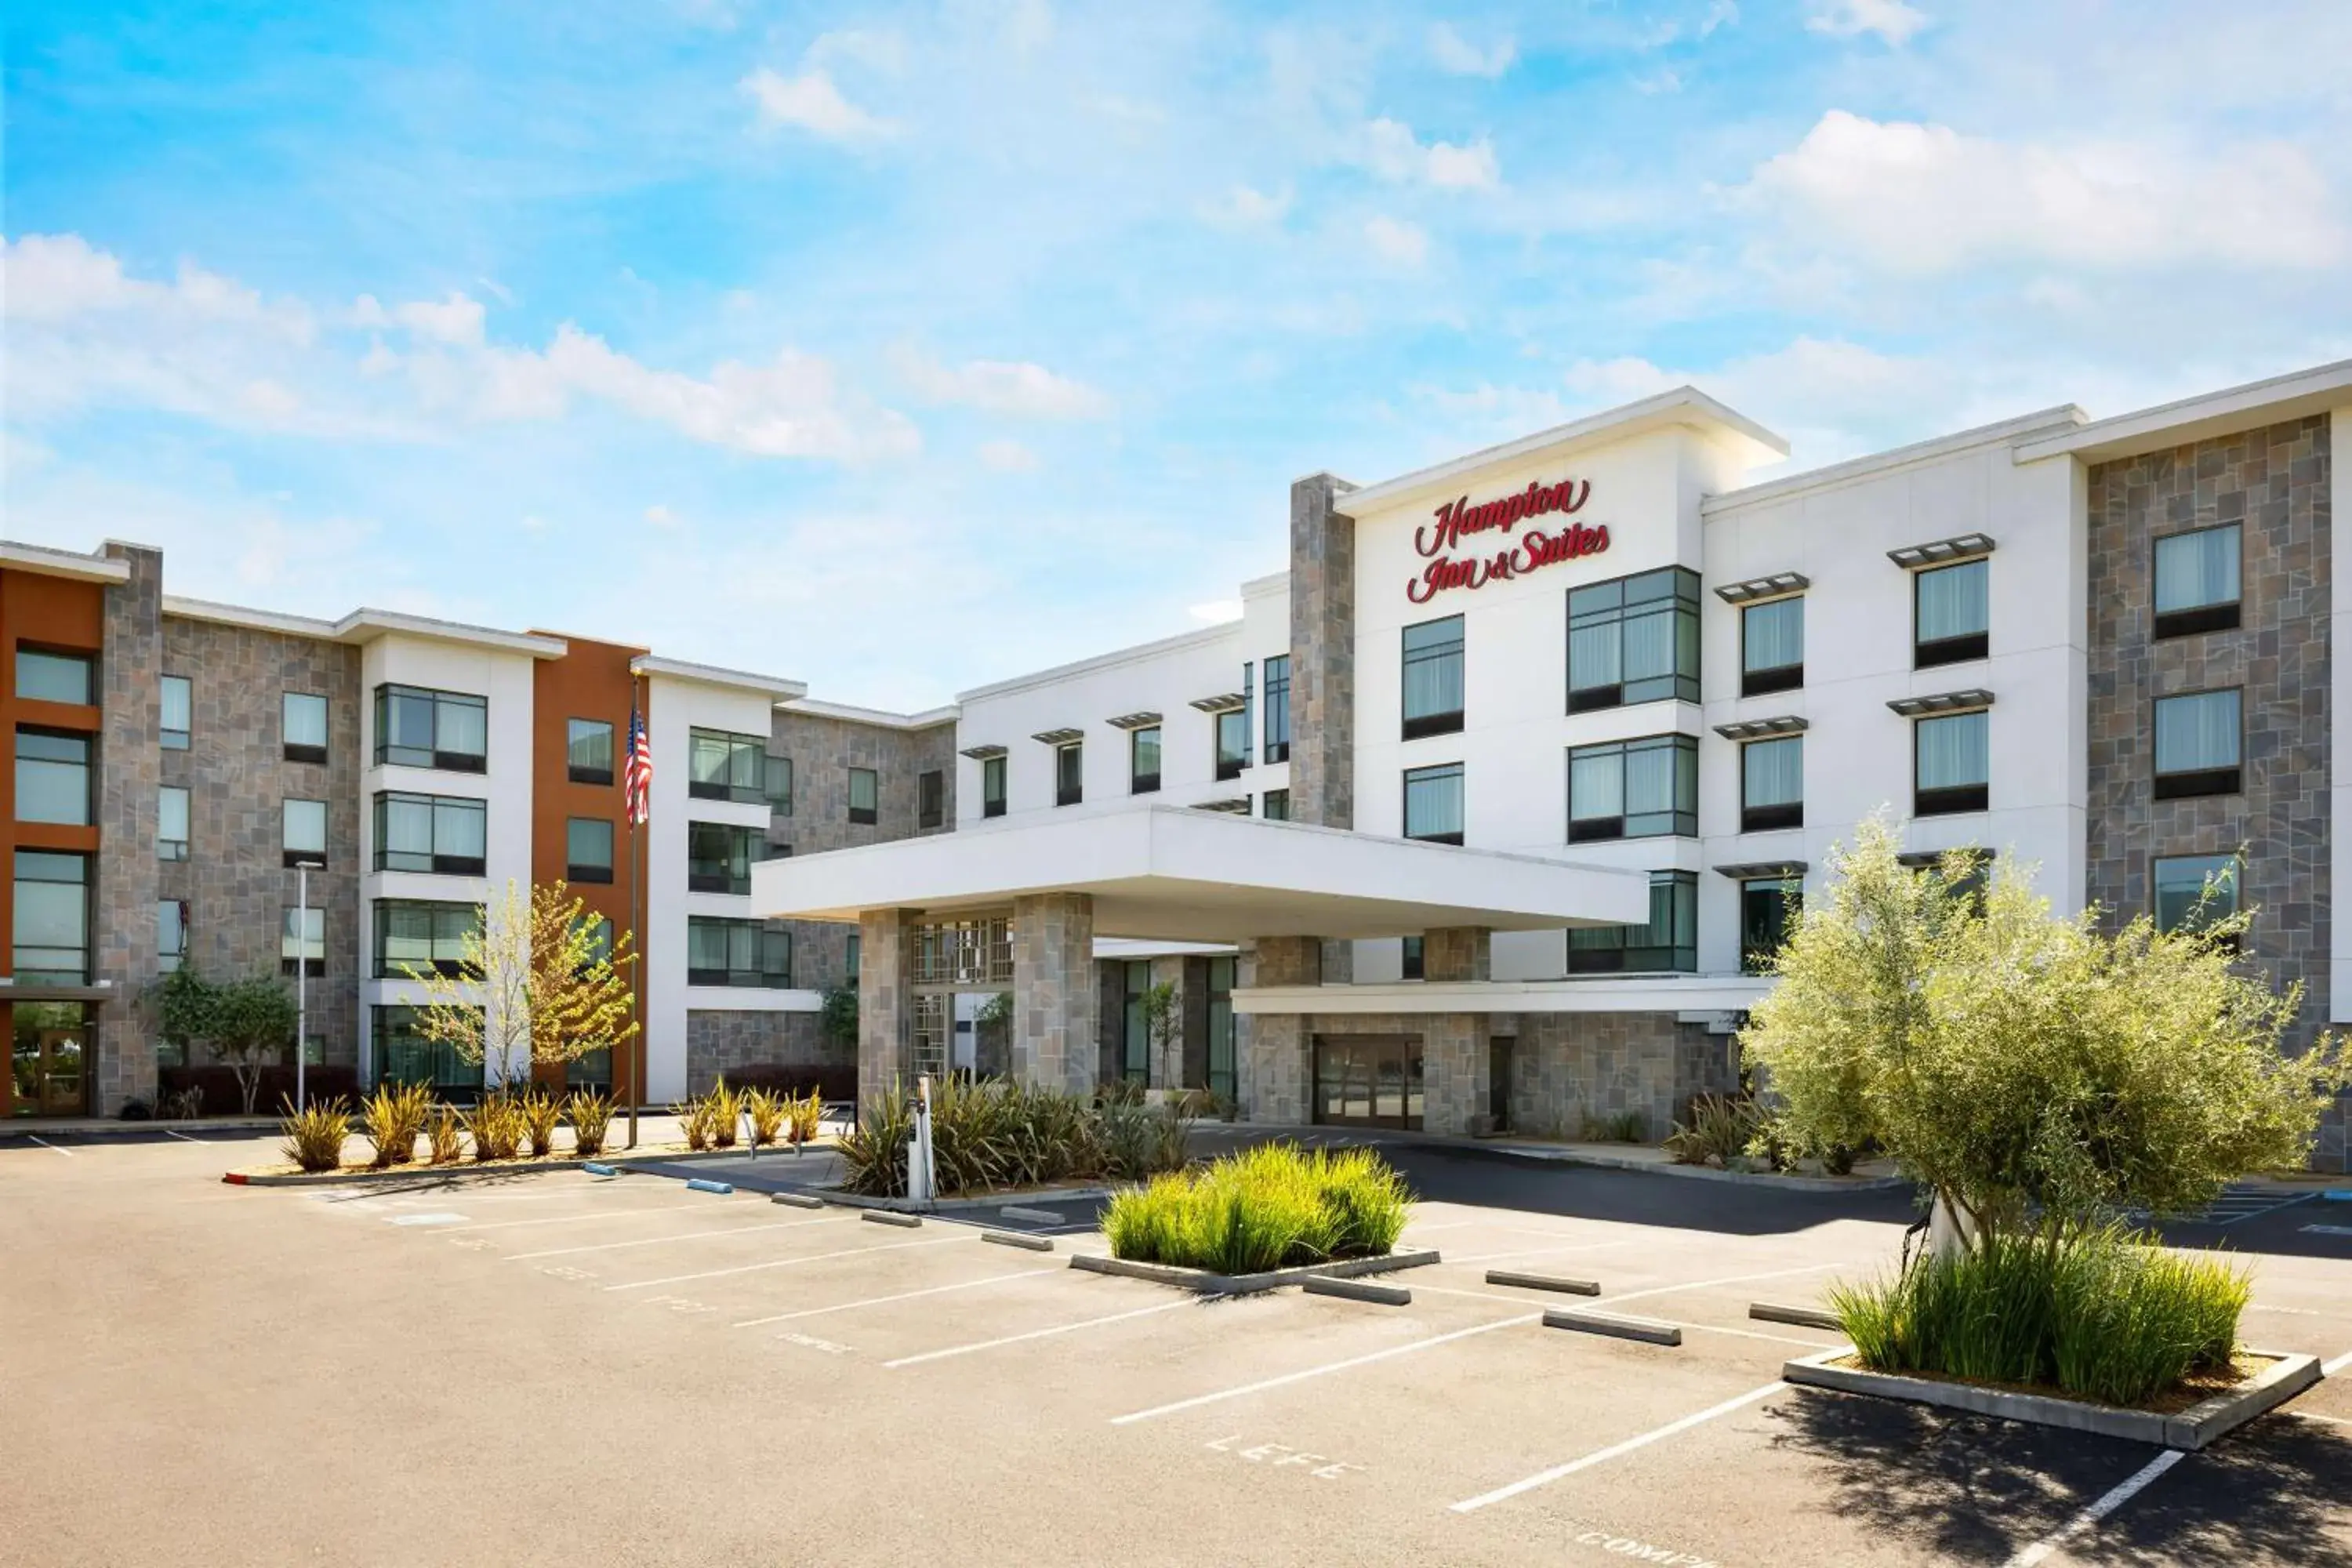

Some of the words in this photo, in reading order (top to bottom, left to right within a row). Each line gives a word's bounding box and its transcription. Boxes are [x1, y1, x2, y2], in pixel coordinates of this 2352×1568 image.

[1414, 477, 1590, 557] Hampton
[1407, 556, 1491, 603] Inn
[1490, 552, 1515, 580] &
[1510, 522, 1610, 573] Suites
